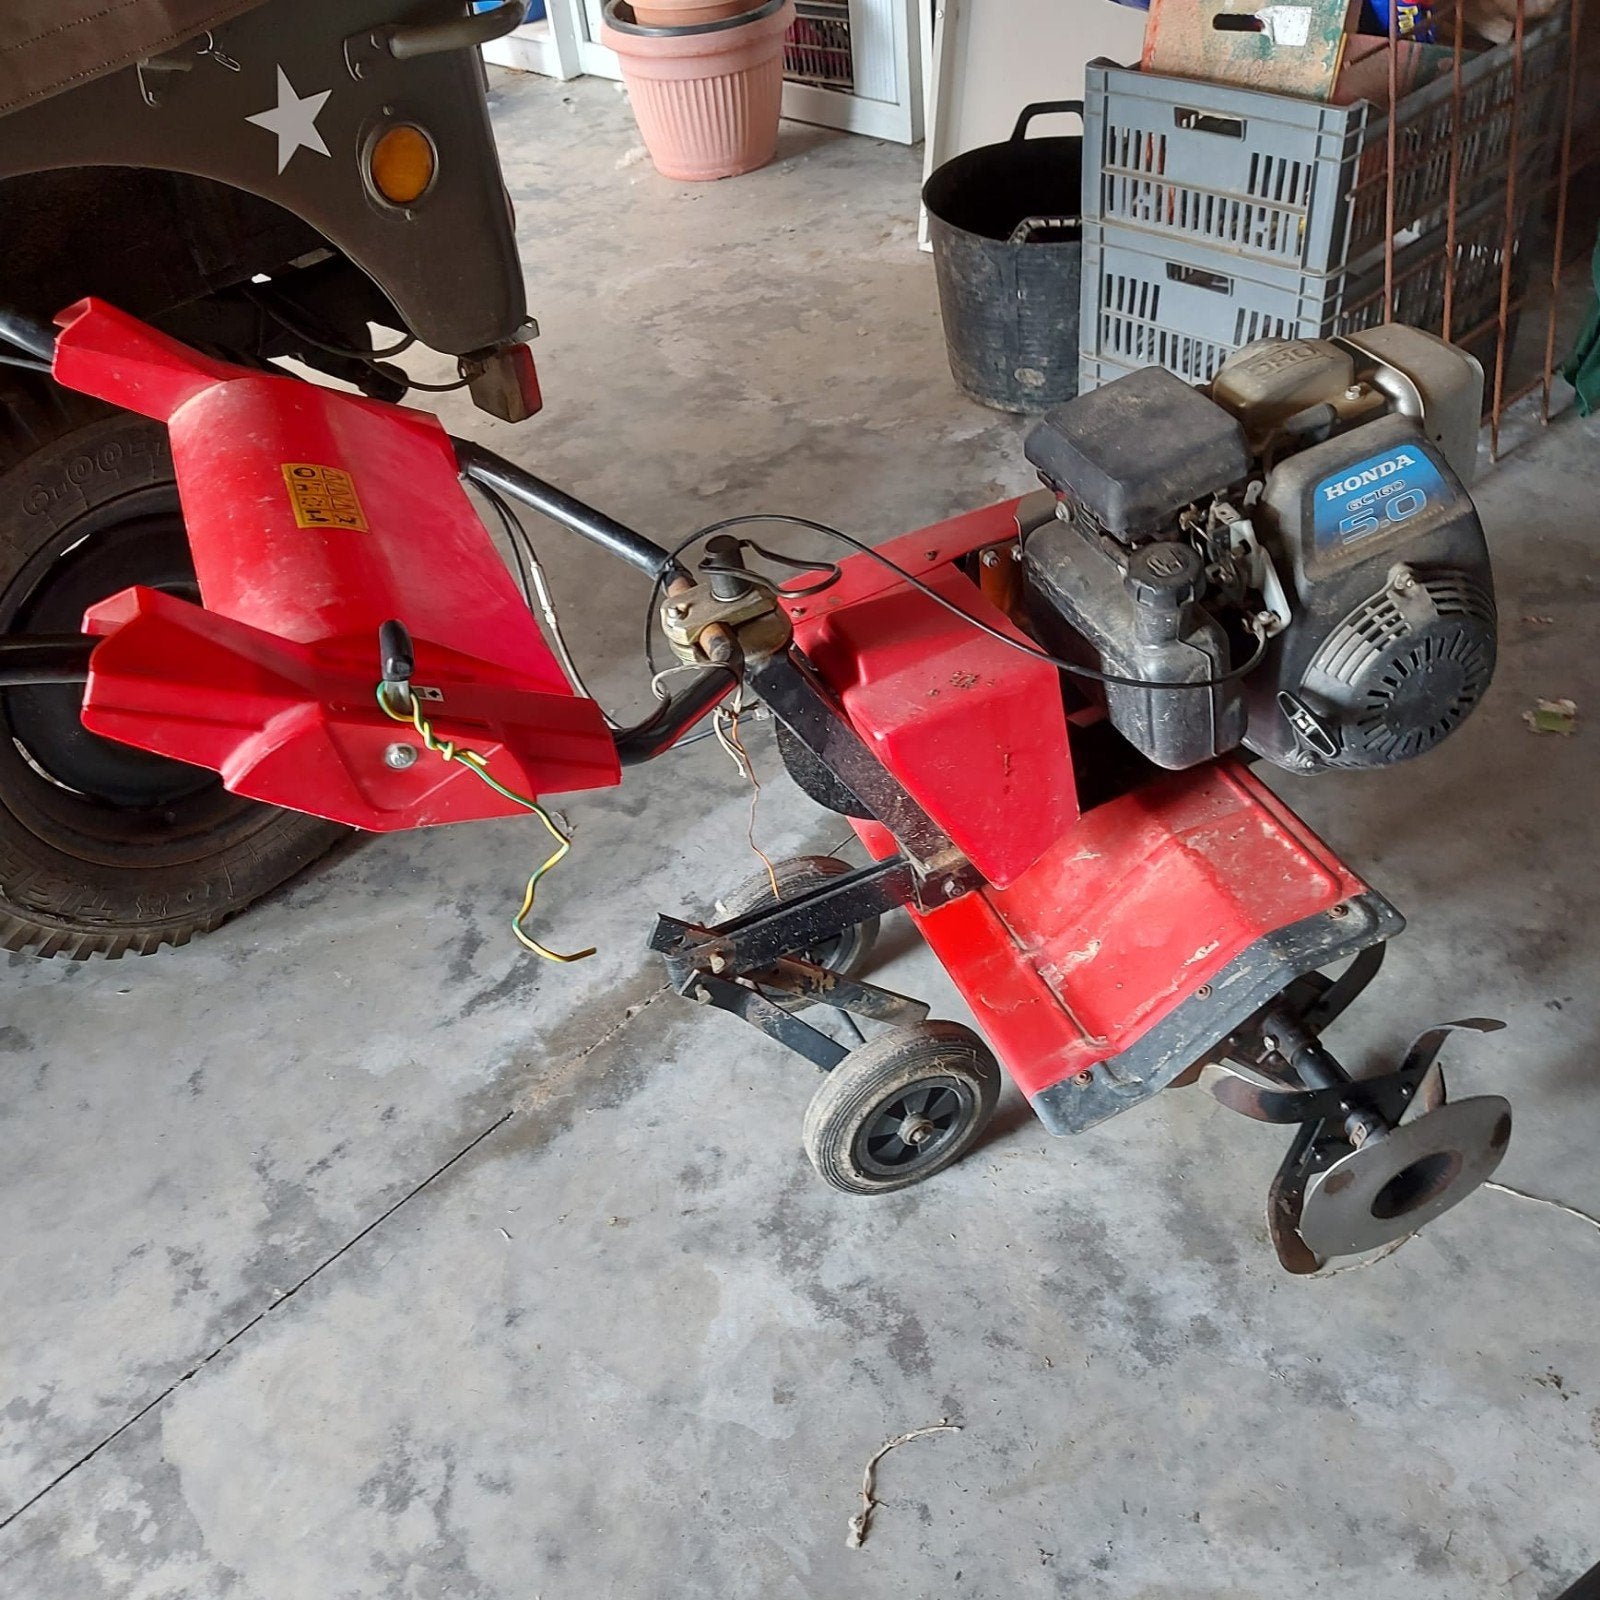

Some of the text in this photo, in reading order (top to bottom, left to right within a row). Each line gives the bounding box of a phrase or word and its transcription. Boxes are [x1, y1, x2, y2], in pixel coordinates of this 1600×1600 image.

[1323, 454, 1416, 501] HONDA
[1346, 480, 1406, 511] GC160
[1338, 488, 1427, 545] 5.0
